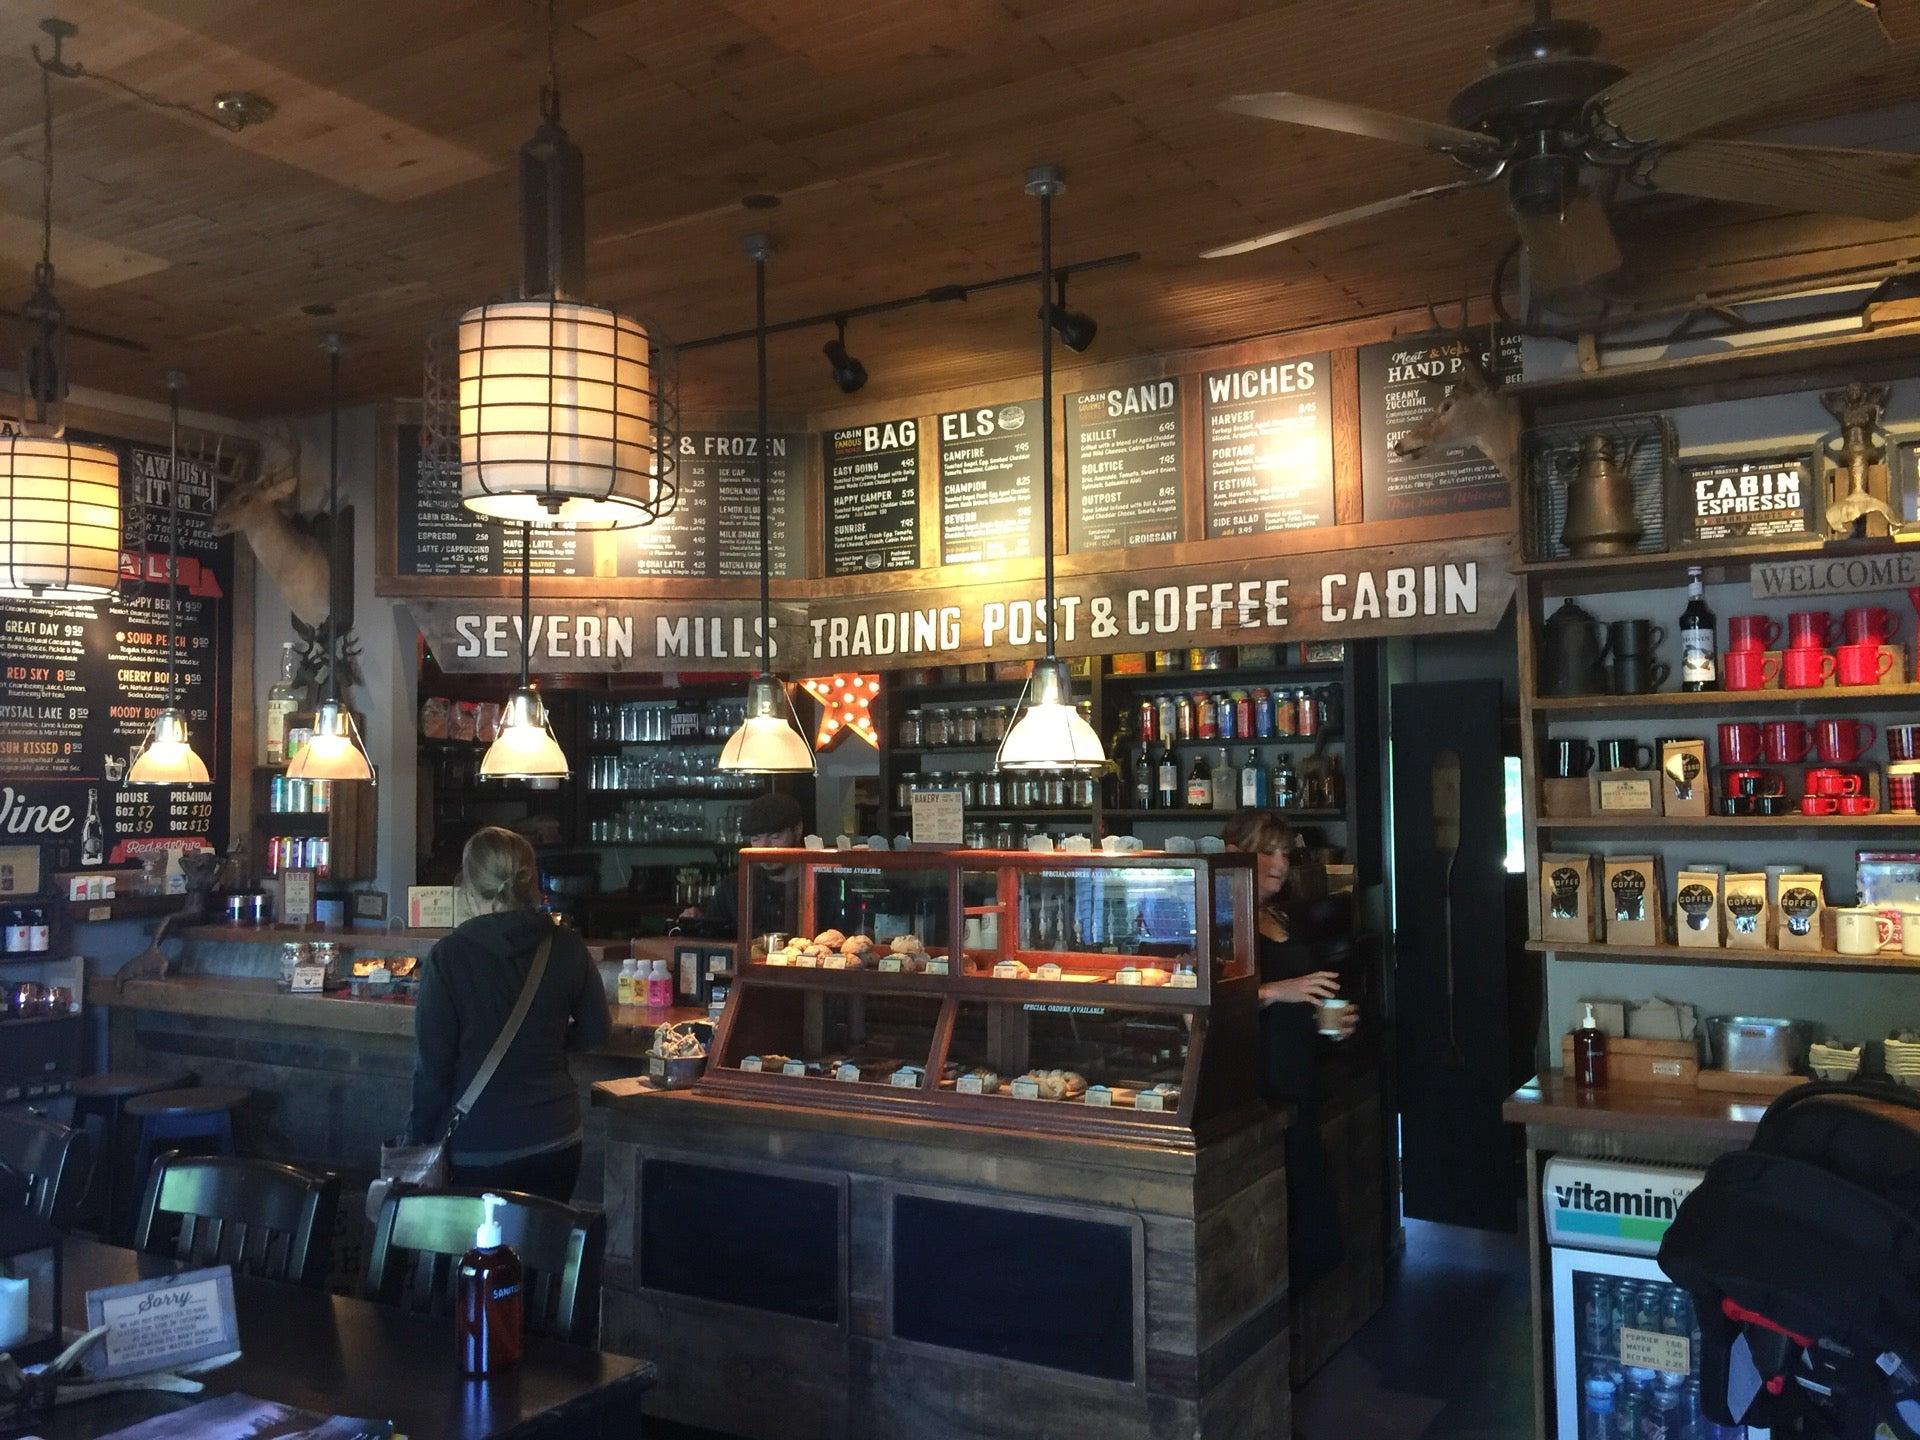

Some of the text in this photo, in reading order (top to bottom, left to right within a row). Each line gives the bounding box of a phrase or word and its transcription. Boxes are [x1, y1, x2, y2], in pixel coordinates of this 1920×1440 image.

[1392, 350, 1428, 364] Meat
[1430, 349, 1441, 359] &
[1387, 361, 1445, 384] HAND
[1209, 361, 1315, 404] WICHES
[1078, 393, 1106, 404] CABIN
[1107, 381, 1174, 417] SAND
[1385, 389, 1421, 403] CREAMY
[1385, 397, 1427, 411] ZUCCHINI
[942, 408, 996, 442] ELS
[1211, 410, 1256, 426] HARVEST
[834, 420, 916, 452] CABIN BAG
[1081, 428, 1118, 444] SKILLET
[680, 436, 696, 456] &
[834, 438, 862, 449] FAMOUS
[944, 448, 985, 463] CAMPFIRE
[833, 465, 854, 477] EASY
[855, 462, 879, 474] GOING
[1082, 460, 1124, 476] SOLSTICE
[944, 480, 988, 496] CHAMPION
[1213, 476, 1258, 492] FESTIVAL
[1696, 471, 1800, 501] CABIN
[720, 488, 743, 496] MOCHA
[834, 495, 858, 507] HAPPY
[860, 490, 892, 503] CAMPER
[1081, 492, 1122, 506] OUTPOST
[720, 506, 744, 514] LEMON
[1697, 491, 1801, 516] ESPRESSO
[418, 513, 440, 522] CABIN
[1213, 514, 1259, 528] SIDE SALAD
[720, 531, 736, 539] MILK
[834, 522, 866, 536] SUNRISE
[418, 532, 457, 541] ESPRESSO
[1129, 531, 1178, 545] CROISSANT
[418, 545, 439, 554] LATTE
[446, 546, 490, 555] CAPPUCCINO
[532, 540, 554, 549] LATTE
[664, 560, 684, 568] LATTE
[720, 562, 744, 570] MATCHA
[1760, 556, 1917, 595] WELCOME
[811, 561, 1481, 660] TRADING POST & COFFEE CABIN
[5, 620, 60, 637] GREAT DAY
[126, 632, 186, 648] SOUR PECH
[455, 614, 778, 659] SEVERN MILLS
[6, 667, 50, 682] RED SKY
[118, 668, 152, 684] CHERRY
[0, 706, 62, 720] RYSTAL LAKE
[110, 706, 141, 719] MOODY
[1, 742, 58, 756] SUN KISSED
[116, 791, 212, 804] HOUSE PREMIUM
[914, 794, 940, 804] BAKERY
[138, 804, 213, 820] $7 $10
[136, 820, 154, 834] $9
[188, 818, 210, 833] $13
[814, 866, 833, 874] SPECIAL
[834, 866, 853, 874] ORDERS
[1555, 878, 1579, 886] OFFEE
[1612, 880, 1644, 888] COFFEE
[1680, 895, 1712, 904] COFFEE
[1728, 898, 1763, 907] COFFEE
[1782, 898, 1817, 909] COFFEE
[1022, 1004, 1104, 1015] SPECIAL ORDERS AVAILABLE
[138, 1290, 193, 1314] Sorry
[1626, 1344, 1651, 1353] WATER
